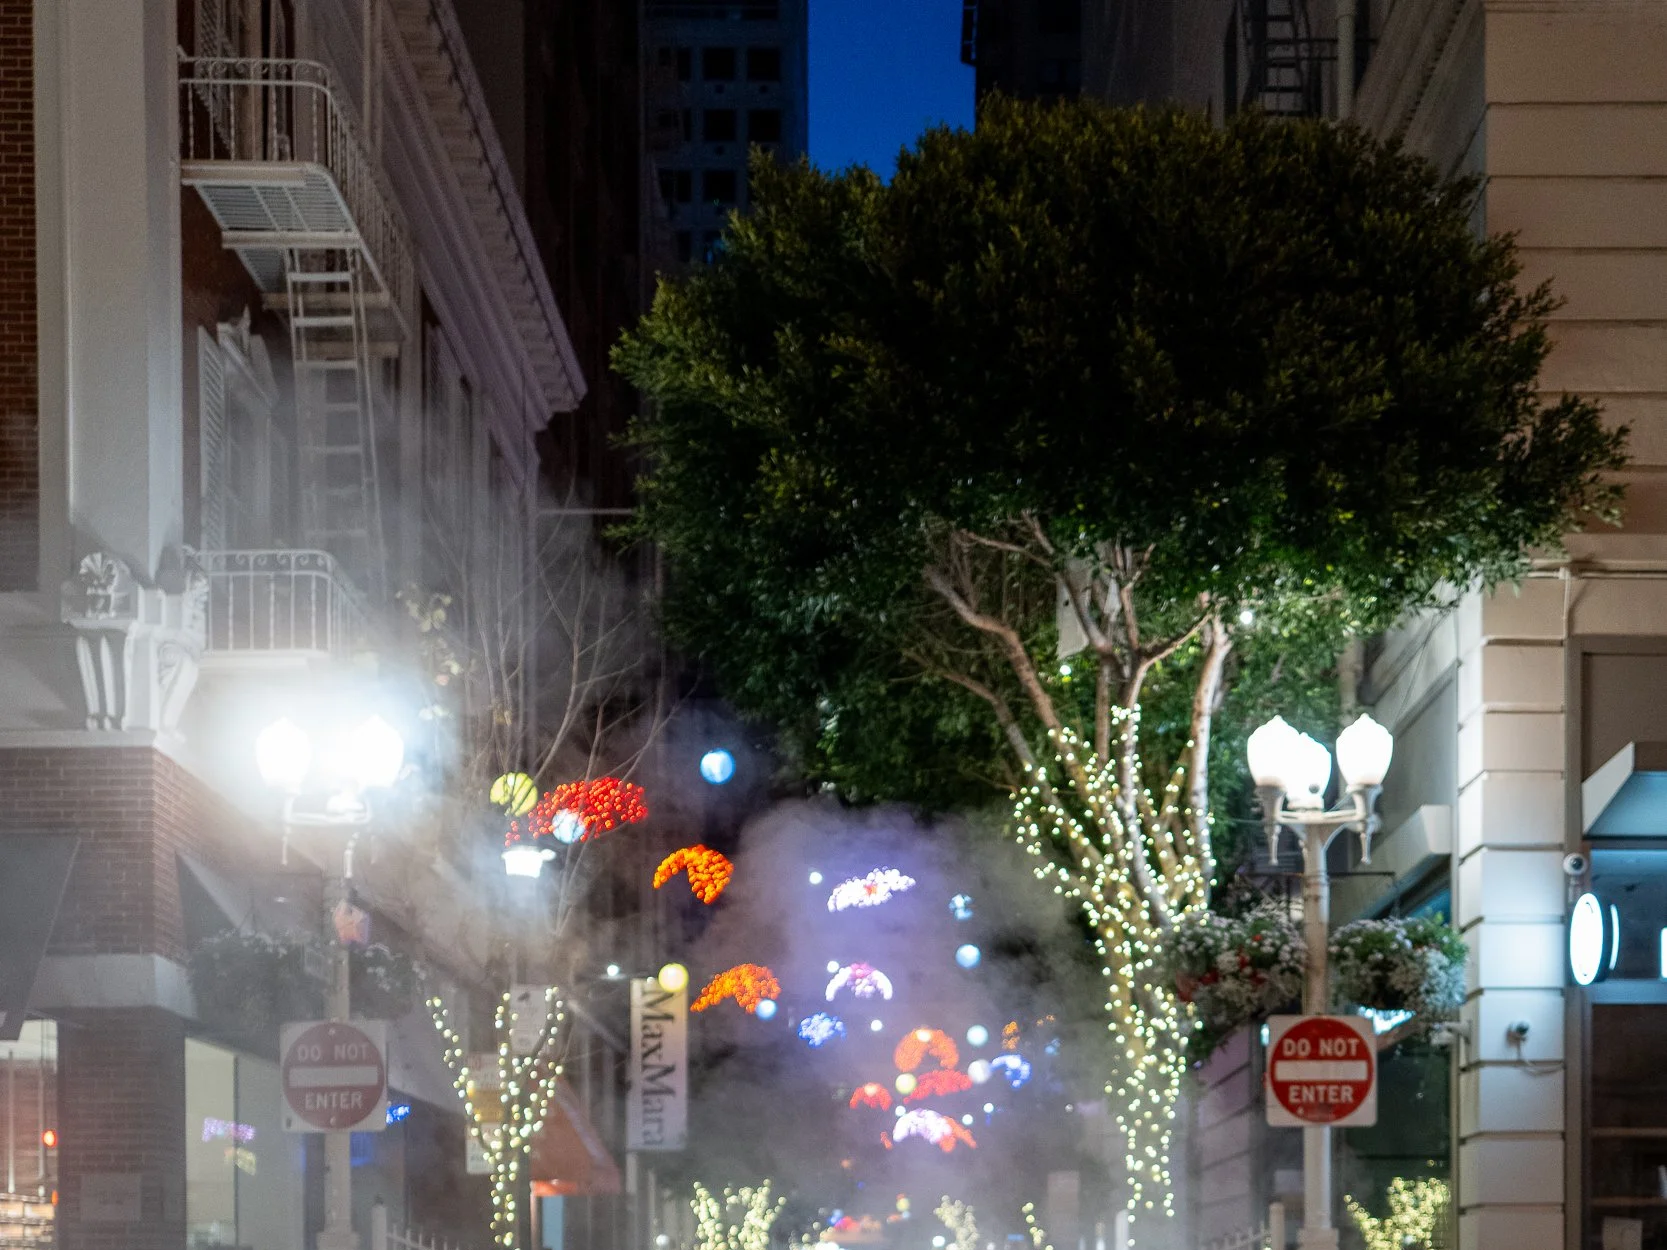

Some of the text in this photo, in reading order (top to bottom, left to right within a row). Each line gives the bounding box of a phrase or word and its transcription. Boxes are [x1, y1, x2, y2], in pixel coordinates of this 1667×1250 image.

[297, 1043, 369, 1061] DO NOT
[1282, 1038, 1359, 1057] DO NOT
[641, 981, 676, 1146] MaxMara
[304, 1091, 363, 1109] ENTER
[1289, 1085, 1353, 1103] ENTER
